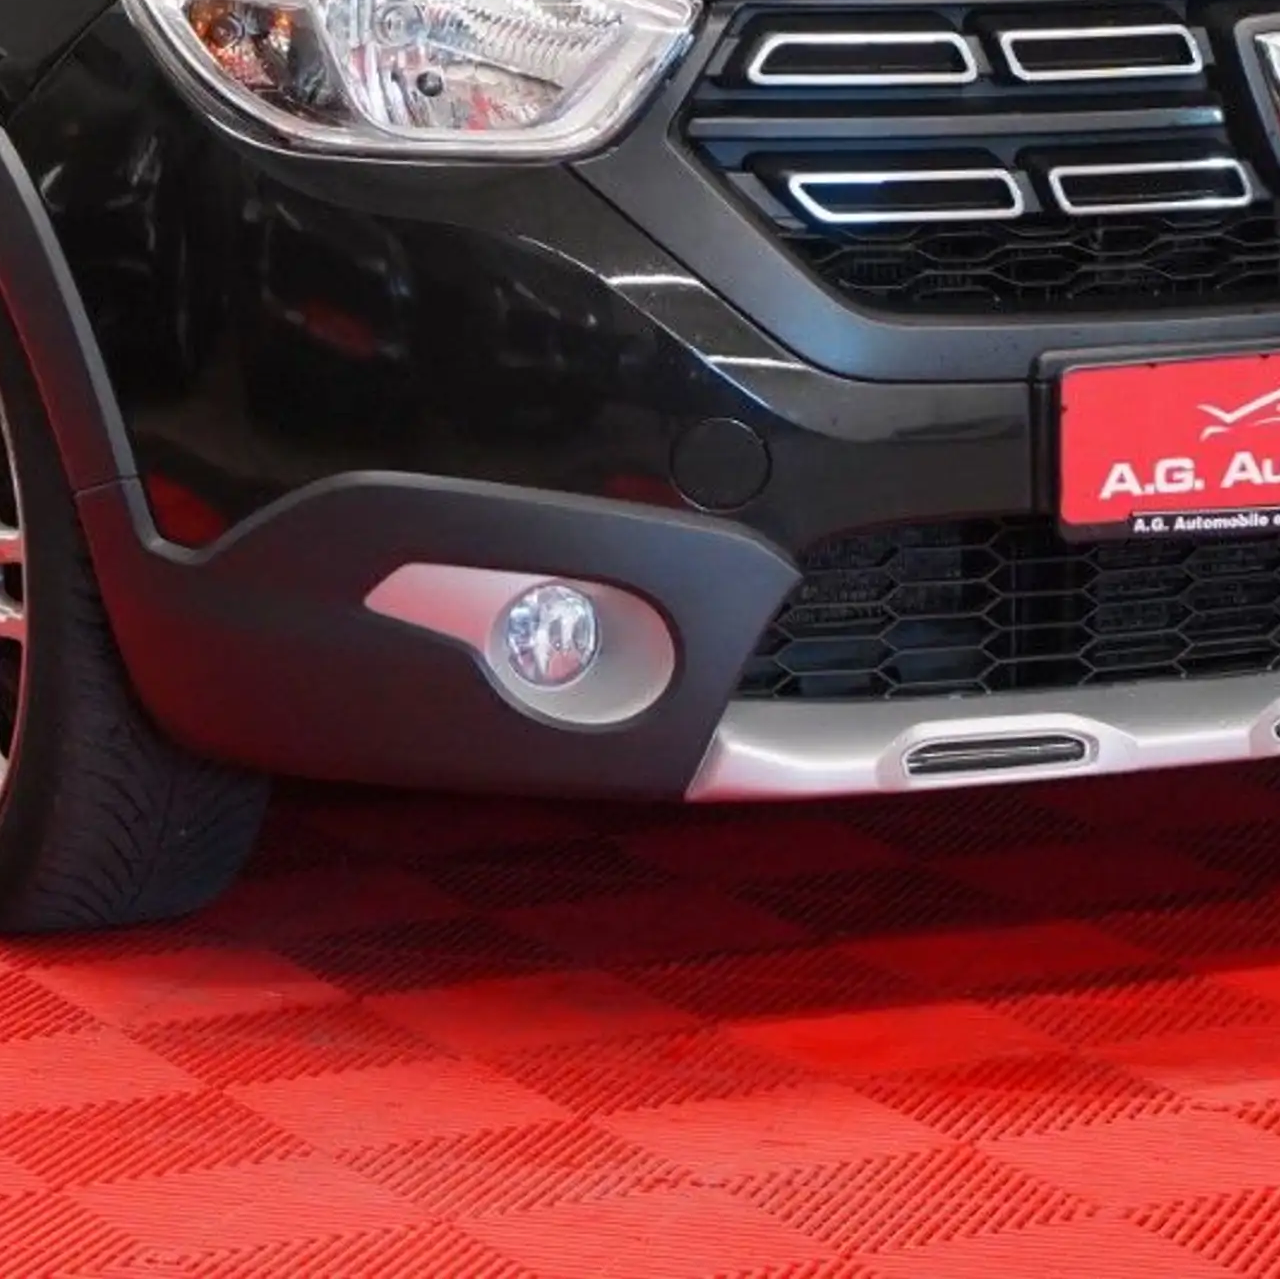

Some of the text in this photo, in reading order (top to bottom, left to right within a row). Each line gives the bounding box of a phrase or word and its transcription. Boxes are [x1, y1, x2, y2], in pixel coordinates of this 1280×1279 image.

[1099, 457, 1205, 500] A.G.
[1133, 516, 1169, 533] A.G.
[1173, 513, 1269, 532] Automobile
